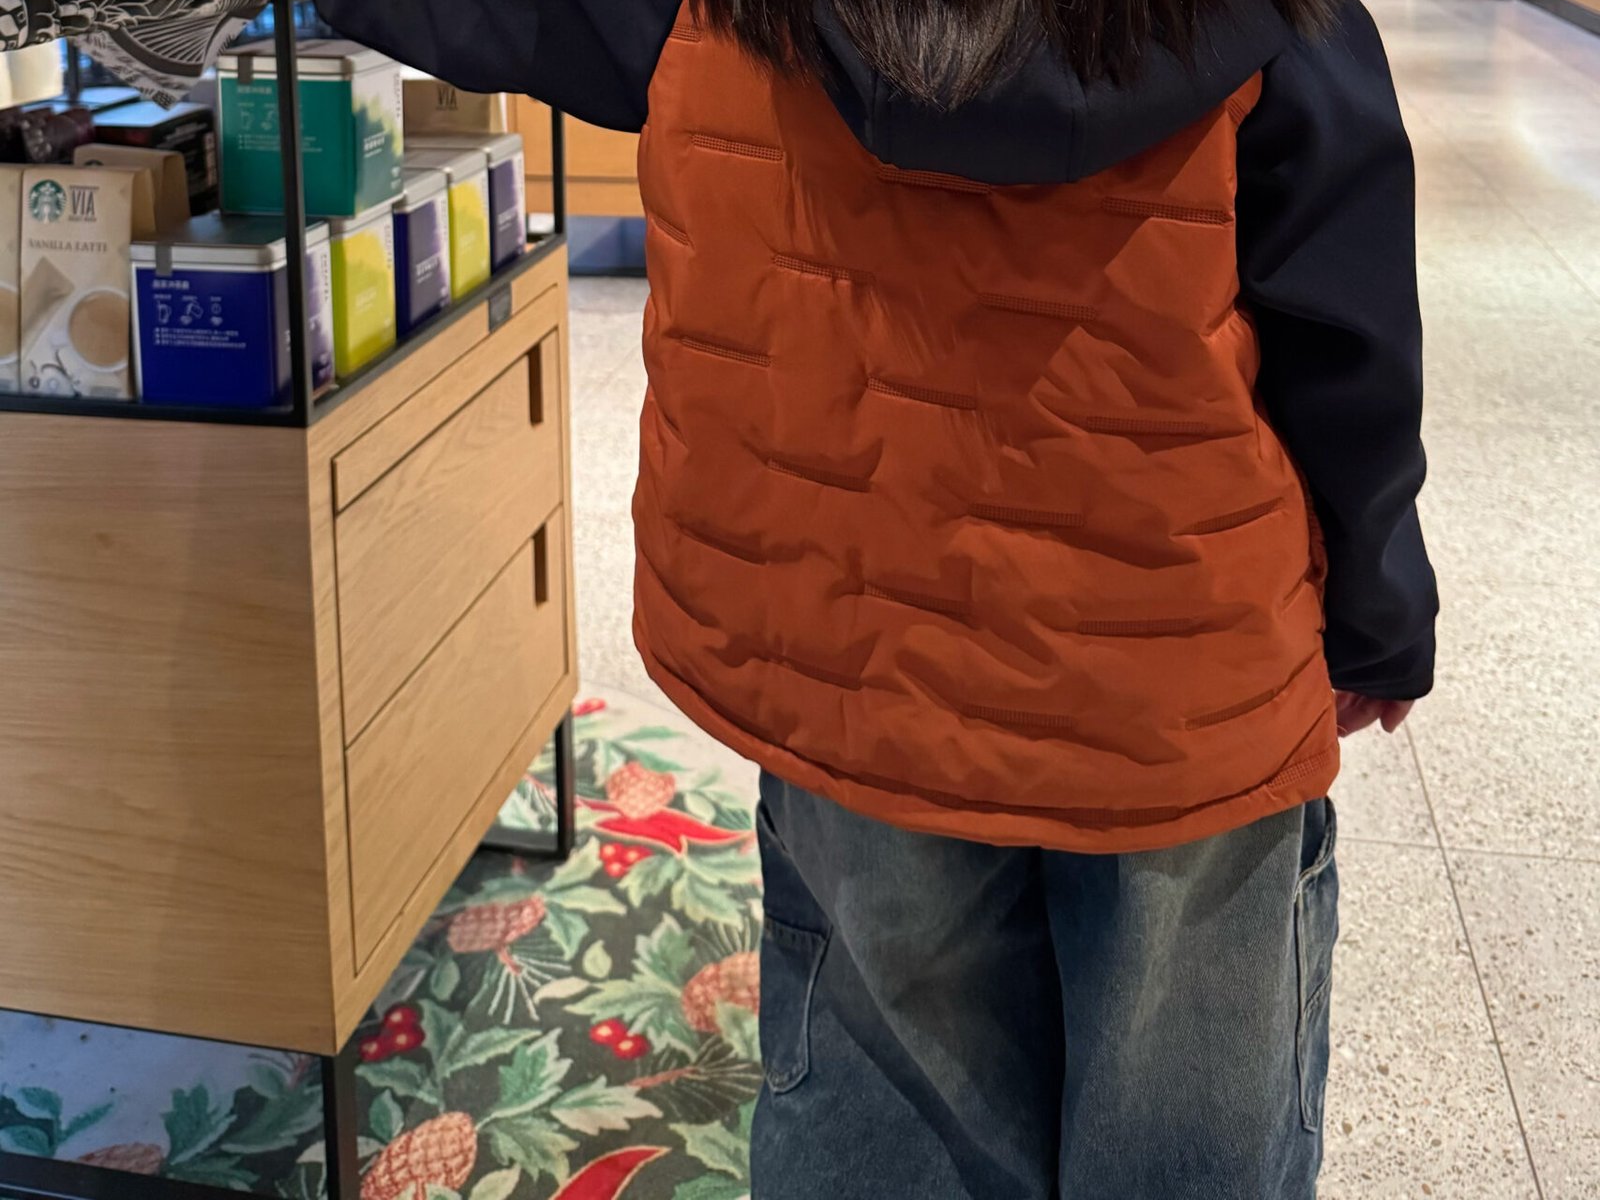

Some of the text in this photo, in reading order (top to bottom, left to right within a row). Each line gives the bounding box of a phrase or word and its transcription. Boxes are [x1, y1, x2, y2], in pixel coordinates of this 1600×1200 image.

[71, 190, 96, 215] VIA
[29, 239, 108, 253] VANILLA LATTE
